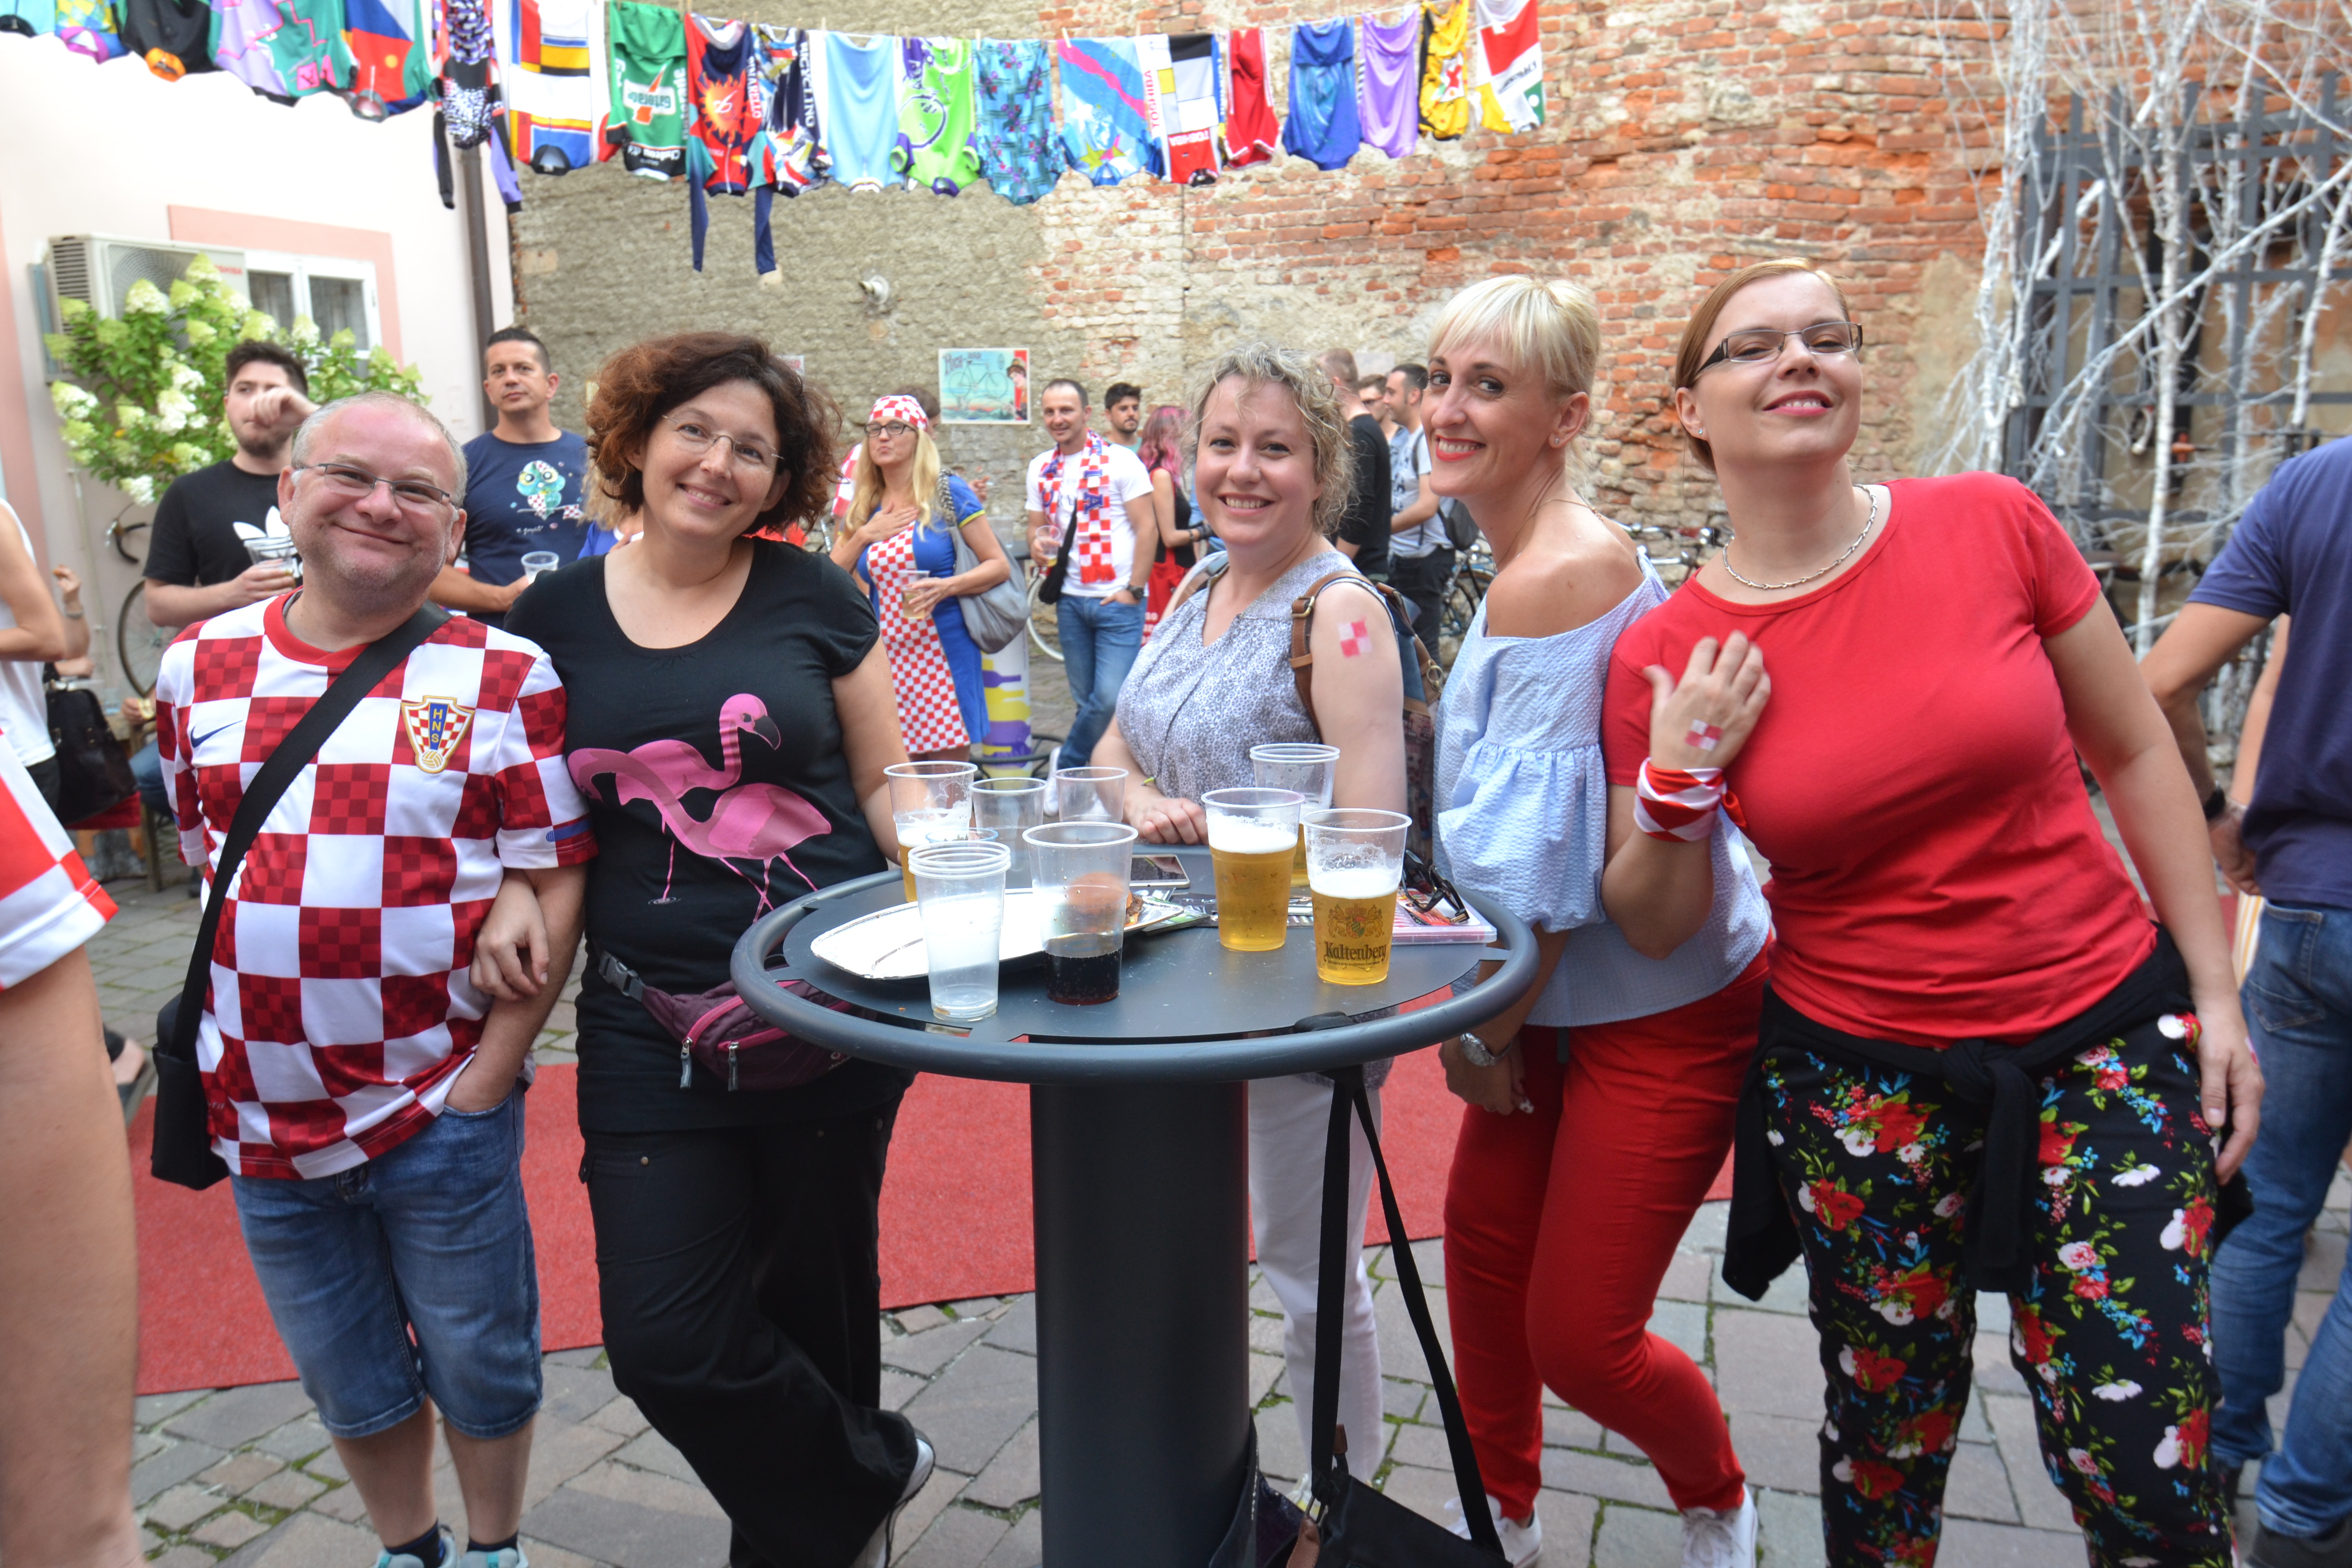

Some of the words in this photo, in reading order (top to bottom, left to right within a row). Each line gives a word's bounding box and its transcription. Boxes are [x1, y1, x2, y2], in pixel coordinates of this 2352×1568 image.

[1144, 69, 1160, 129] TOSHIBA
[1169, 129, 1210, 147] TOSHIBA
[431, 708, 443, 743] HNS
[1324, 941, 1387, 963] Kaltenberg
